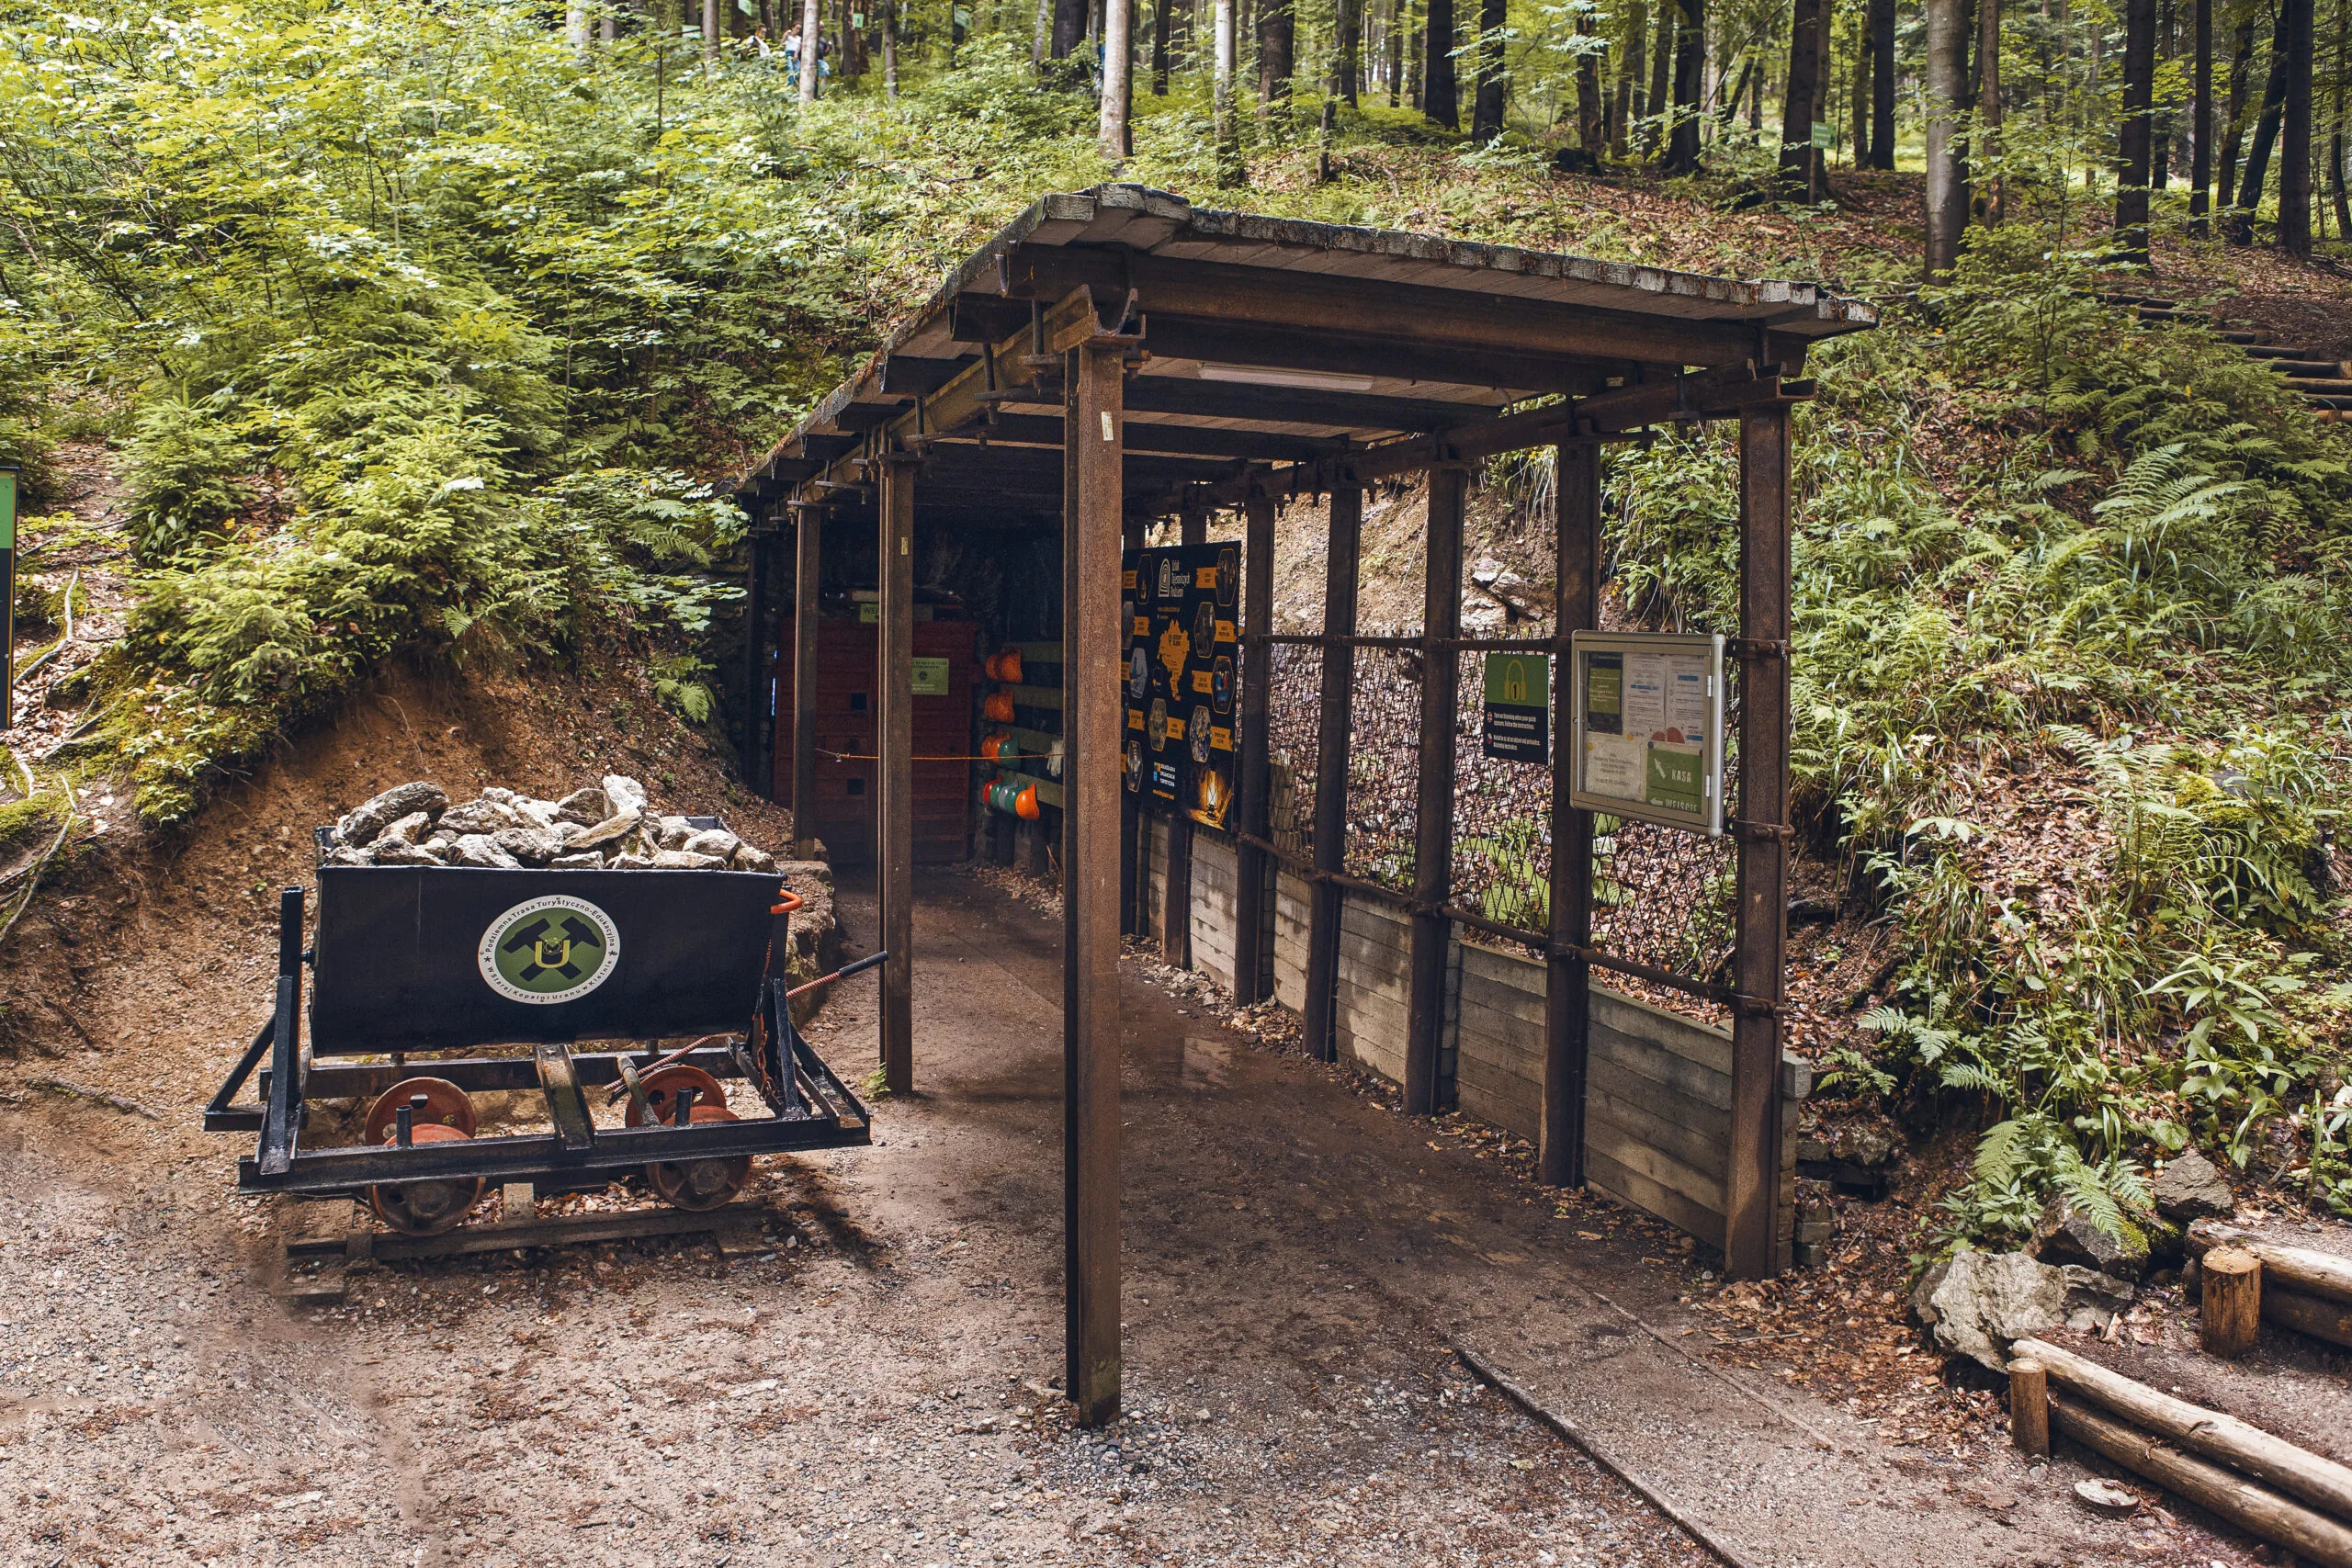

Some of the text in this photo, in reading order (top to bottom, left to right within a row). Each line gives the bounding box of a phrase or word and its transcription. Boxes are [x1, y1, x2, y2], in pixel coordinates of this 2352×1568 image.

[1512, 682, 1517, 699] 1
[1671, 769, 1692, 784] KASA
[485, 899, 616, 953] Podziemna Trasa Turystyczno-Edukacyjna
[535, 939, 571, 969] U
[491, 974, 513, 993] Starej
[513, 990, 549, 1000] Kopalni
[552, 989, 581, 999] Uranu
